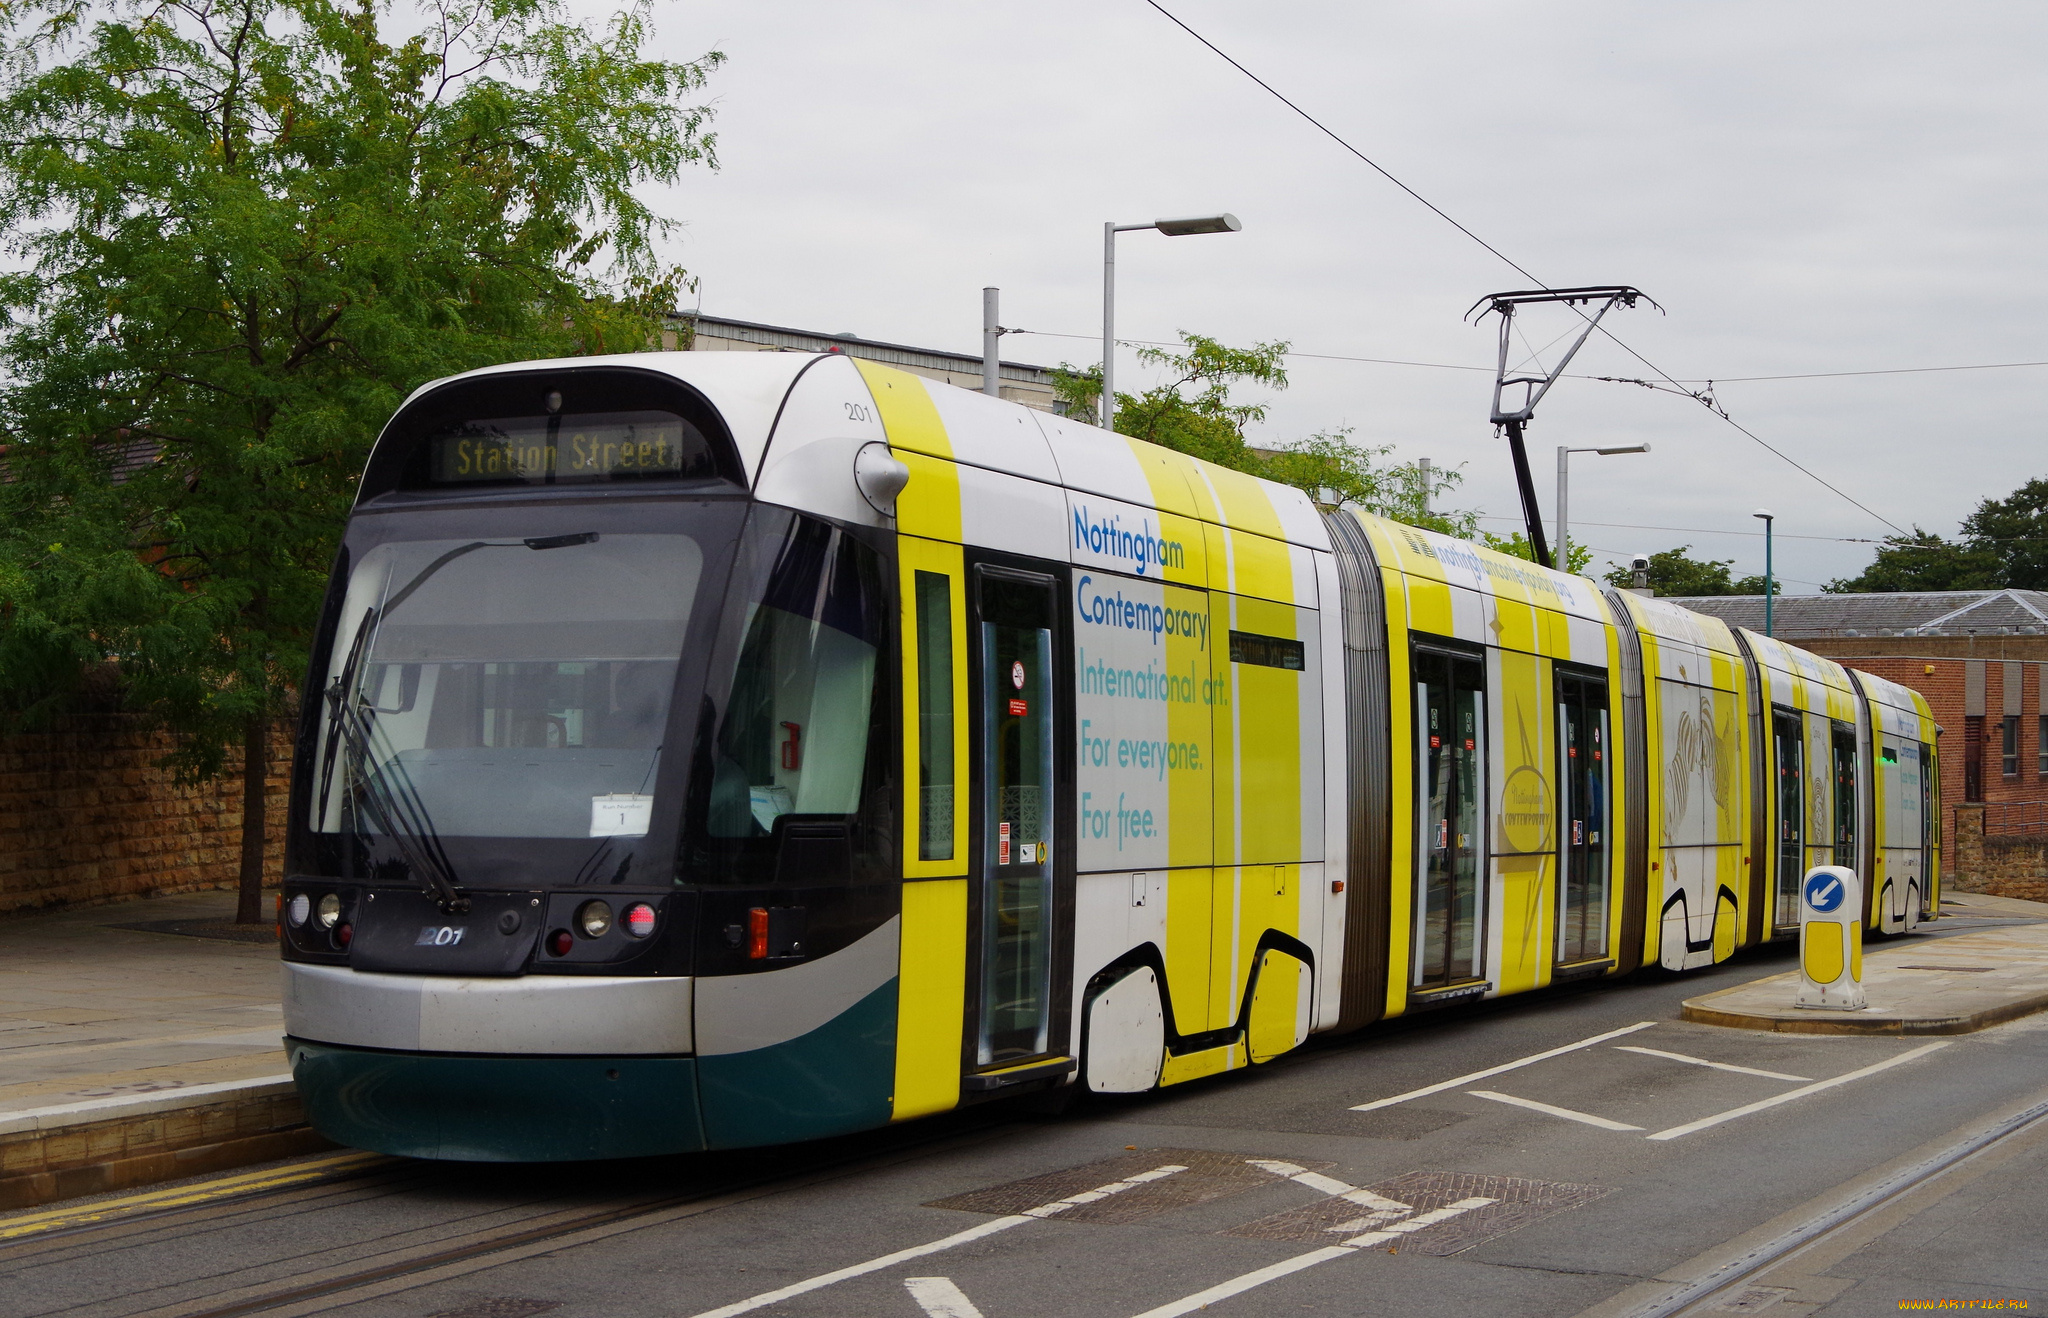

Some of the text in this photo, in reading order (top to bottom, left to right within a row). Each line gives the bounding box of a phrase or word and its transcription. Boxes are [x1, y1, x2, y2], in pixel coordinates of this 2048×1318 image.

[844, 402, 873, 423] 201
[457, 433, 668, 476] Station Street
[1073, 503, 1185, 575] Nottingham
[1077, 575, 1208, 652] Contemporary
[1080, 647, 1228, 706] International art.
[1081, 719, 1203, 782] For everyone.
[620, 812, 625, 826] 1
[1081, 791, 1157, 851] For free.
[414, 926, 464, 946] 201
